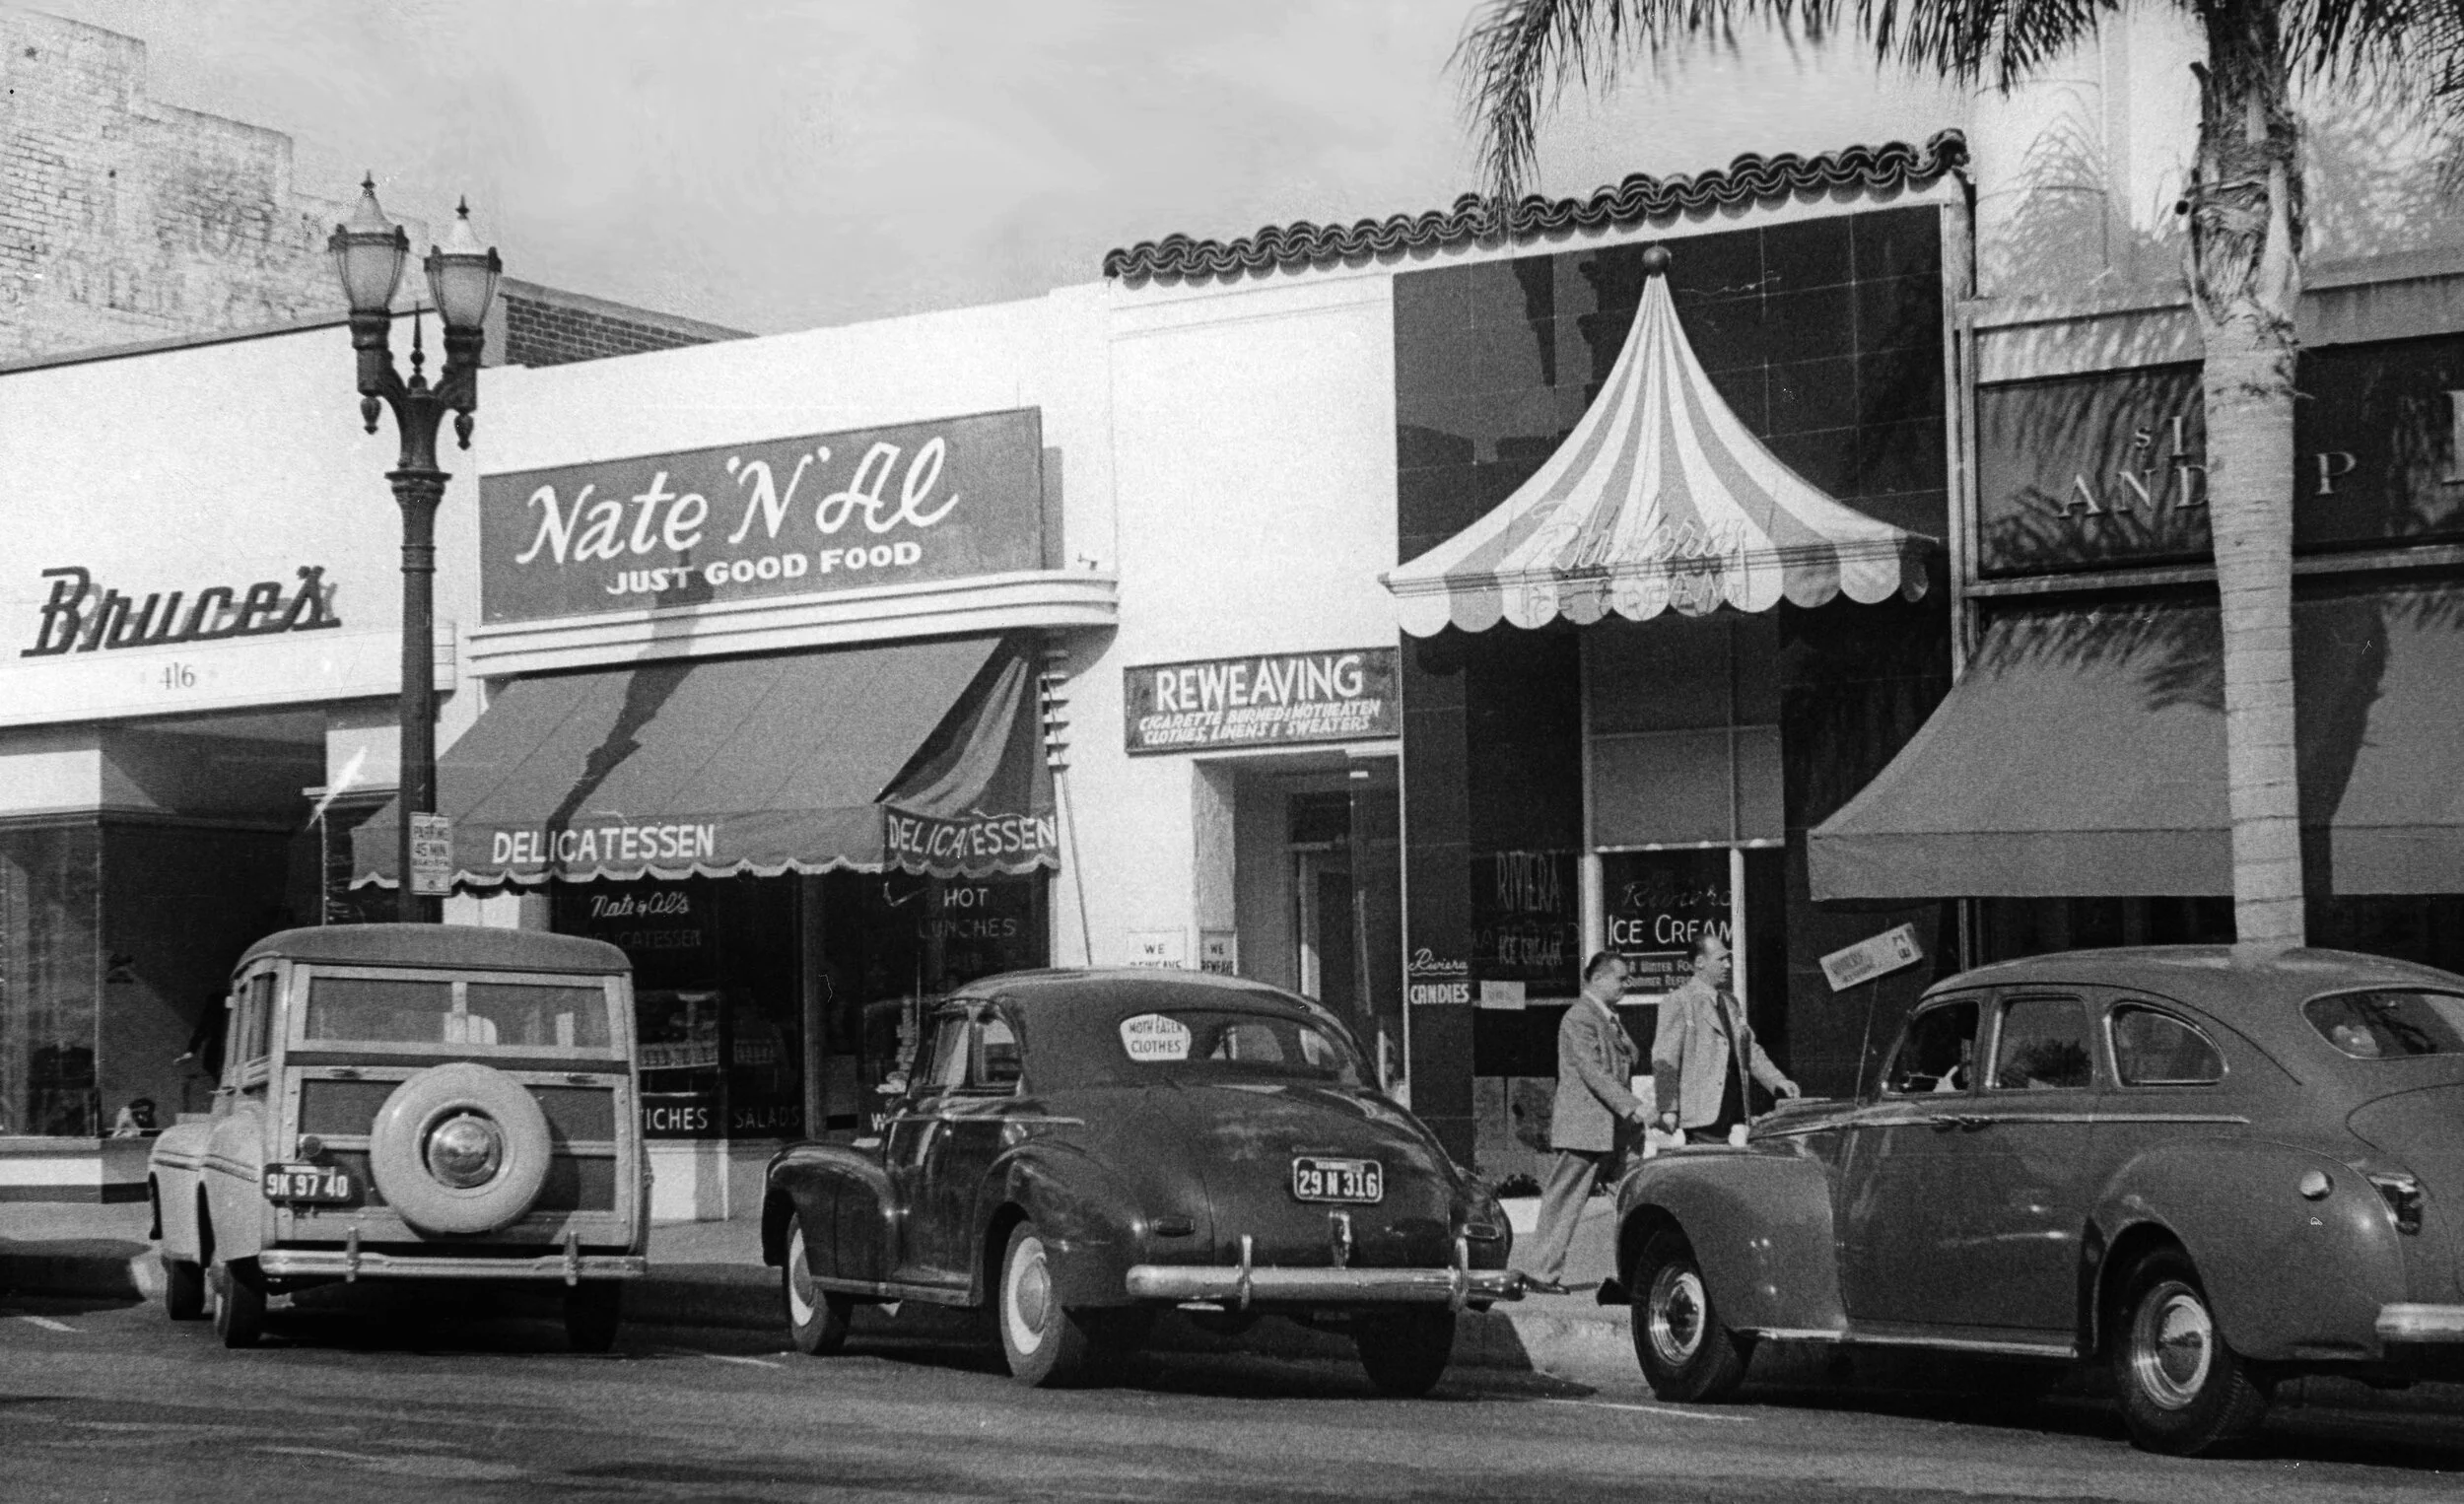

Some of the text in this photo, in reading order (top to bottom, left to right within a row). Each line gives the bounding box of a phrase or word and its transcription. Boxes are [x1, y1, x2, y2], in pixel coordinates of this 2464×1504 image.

[513, 470, 710, 565] Nate
[814, 436, 960, 534] Al
[605, 540, 923, 595] JUST GOOD FOOD
[158, 661, 196, 690] 416
[1156, 654, 1364, 712] REWEAVING
[1138, 711, 1223, 731] CIGARETTE
[1210, 720, 1269, 741] LINENS
[1286, 715, 1370, 737] SWEATERS
[492, 823, 716, 864] DELICATESSEN
[888, 815, 1058, 858] DELICATESSEN
[590, 893, 635, 918] Nate
[647, 890, 691, 915] Al's
[943, 887, 989, 908] HOT
[1608, 915, 1644, 946] ICE
[1143, 943, 1166, 955] WE
[1209, 943, 1225, 955] WE
[1407, 947, 1469, 972] Riviera
[1409, 983, 1471, 1005] CANDIES
[1129, 1018, 1154, 1034] MOTH
[1130, 1039, 1182, 1054] CLOTHES
[641, 1106, 709, 1132] ICHES
[733, 1103, 800, 1130] SALADS
[1299, 1169, 1323, 1196] 29
[1342, 1172, 1378, 1198] 316
